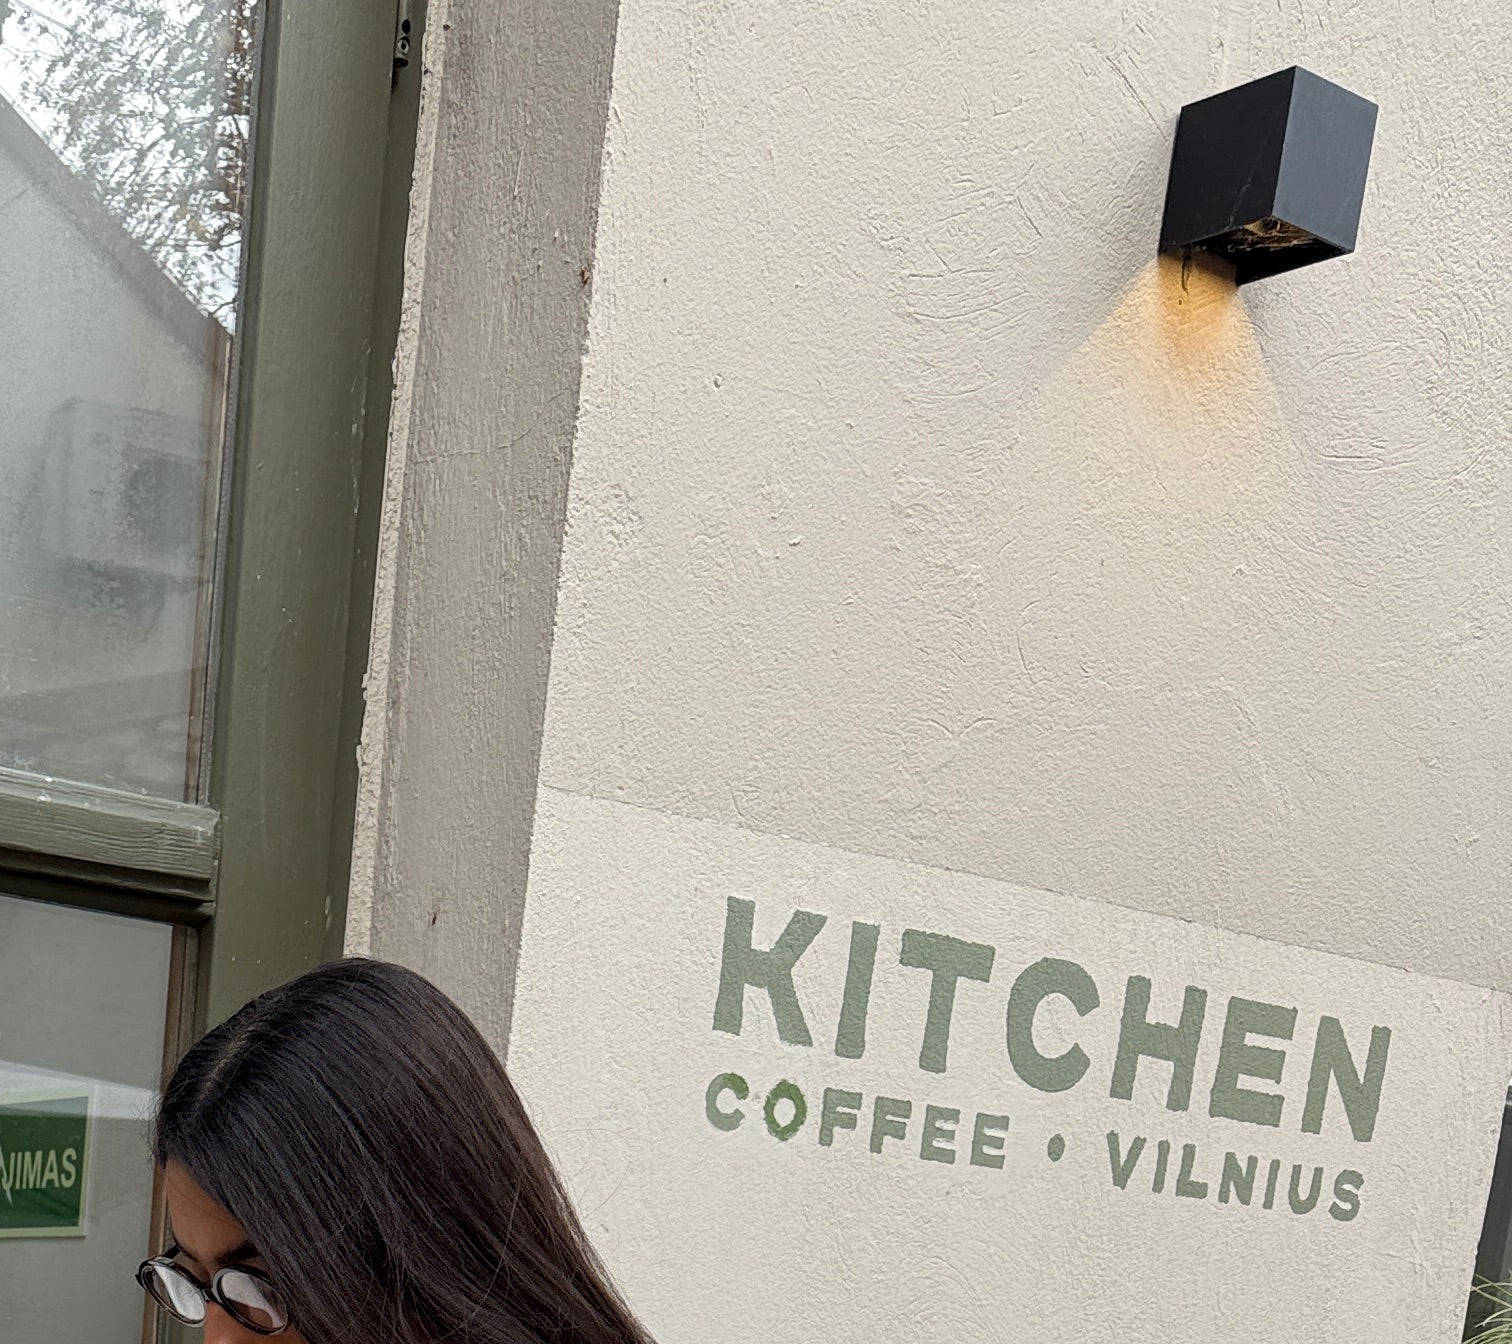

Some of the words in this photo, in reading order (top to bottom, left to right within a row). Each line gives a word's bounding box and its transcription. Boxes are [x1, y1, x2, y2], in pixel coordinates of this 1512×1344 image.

[712, 895, 1392, 1143] KITCHEN
[704, 1072, 1010, 1171] COFFEE
[1105, 1129, 1365, 1222] VILNIUS
